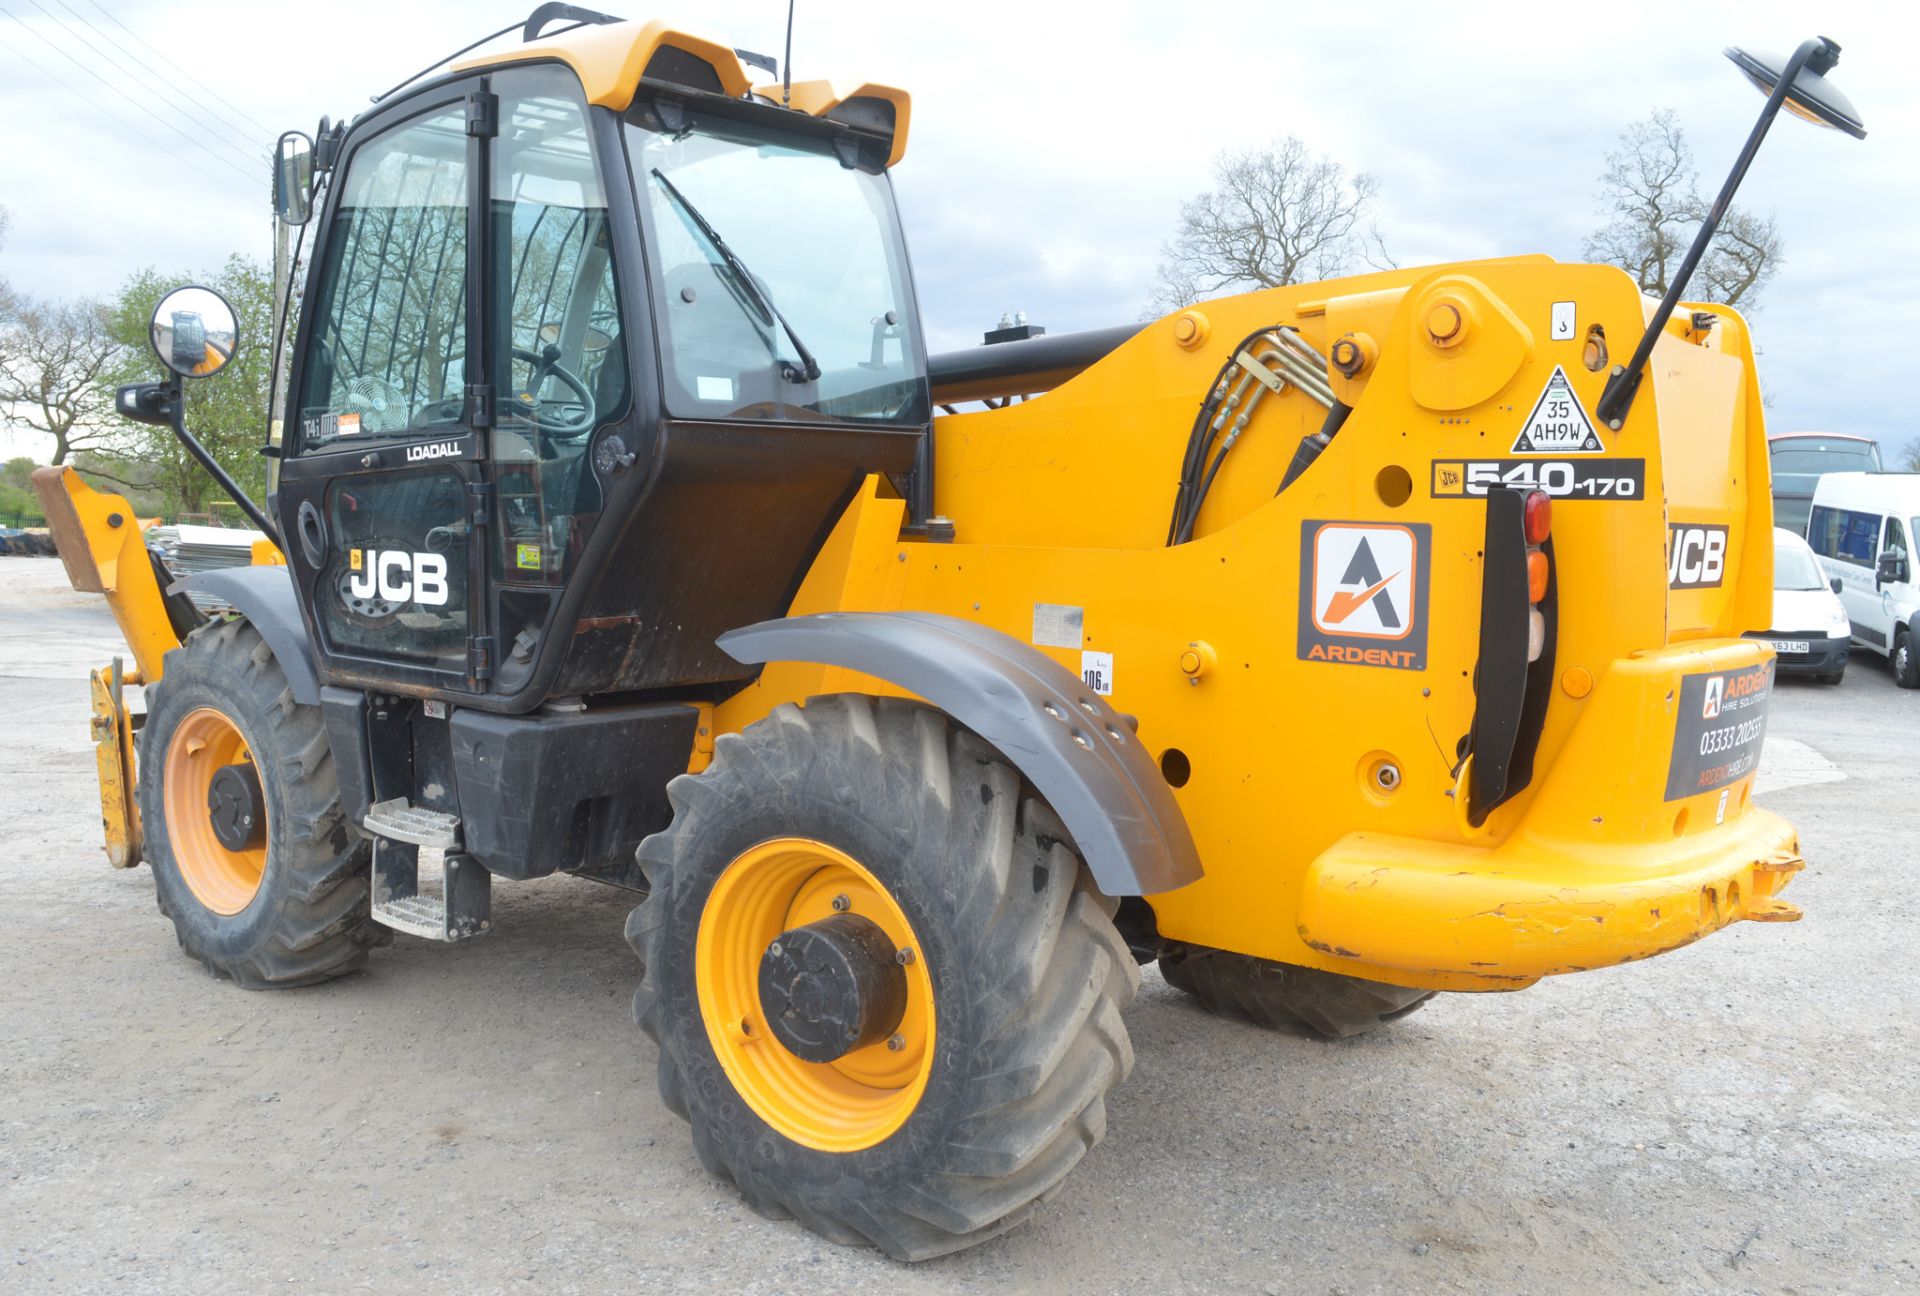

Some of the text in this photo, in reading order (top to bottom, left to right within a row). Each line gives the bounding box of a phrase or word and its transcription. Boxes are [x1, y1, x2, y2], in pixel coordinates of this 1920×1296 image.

[1547, 401, 1569, 419] 35
[304, 418, 320, 438] T4i
[1534, 423, 1581, 441] AH9W
[407, 442, 462, 461] LOADALL
[1440, 470, 1460, 488] JCB
[1669, 529, 1726, 584] JCB
[351, 549, 449, 606] JCB
[1307, 644, 1416, 668] ARDENT
[1790, 643, 1808, 652] LHD
[1084, 670, 1102, 691] 106
[1721, 700, 1738, 712] HIRE
[1700, 726, 1735, 755] 03333
